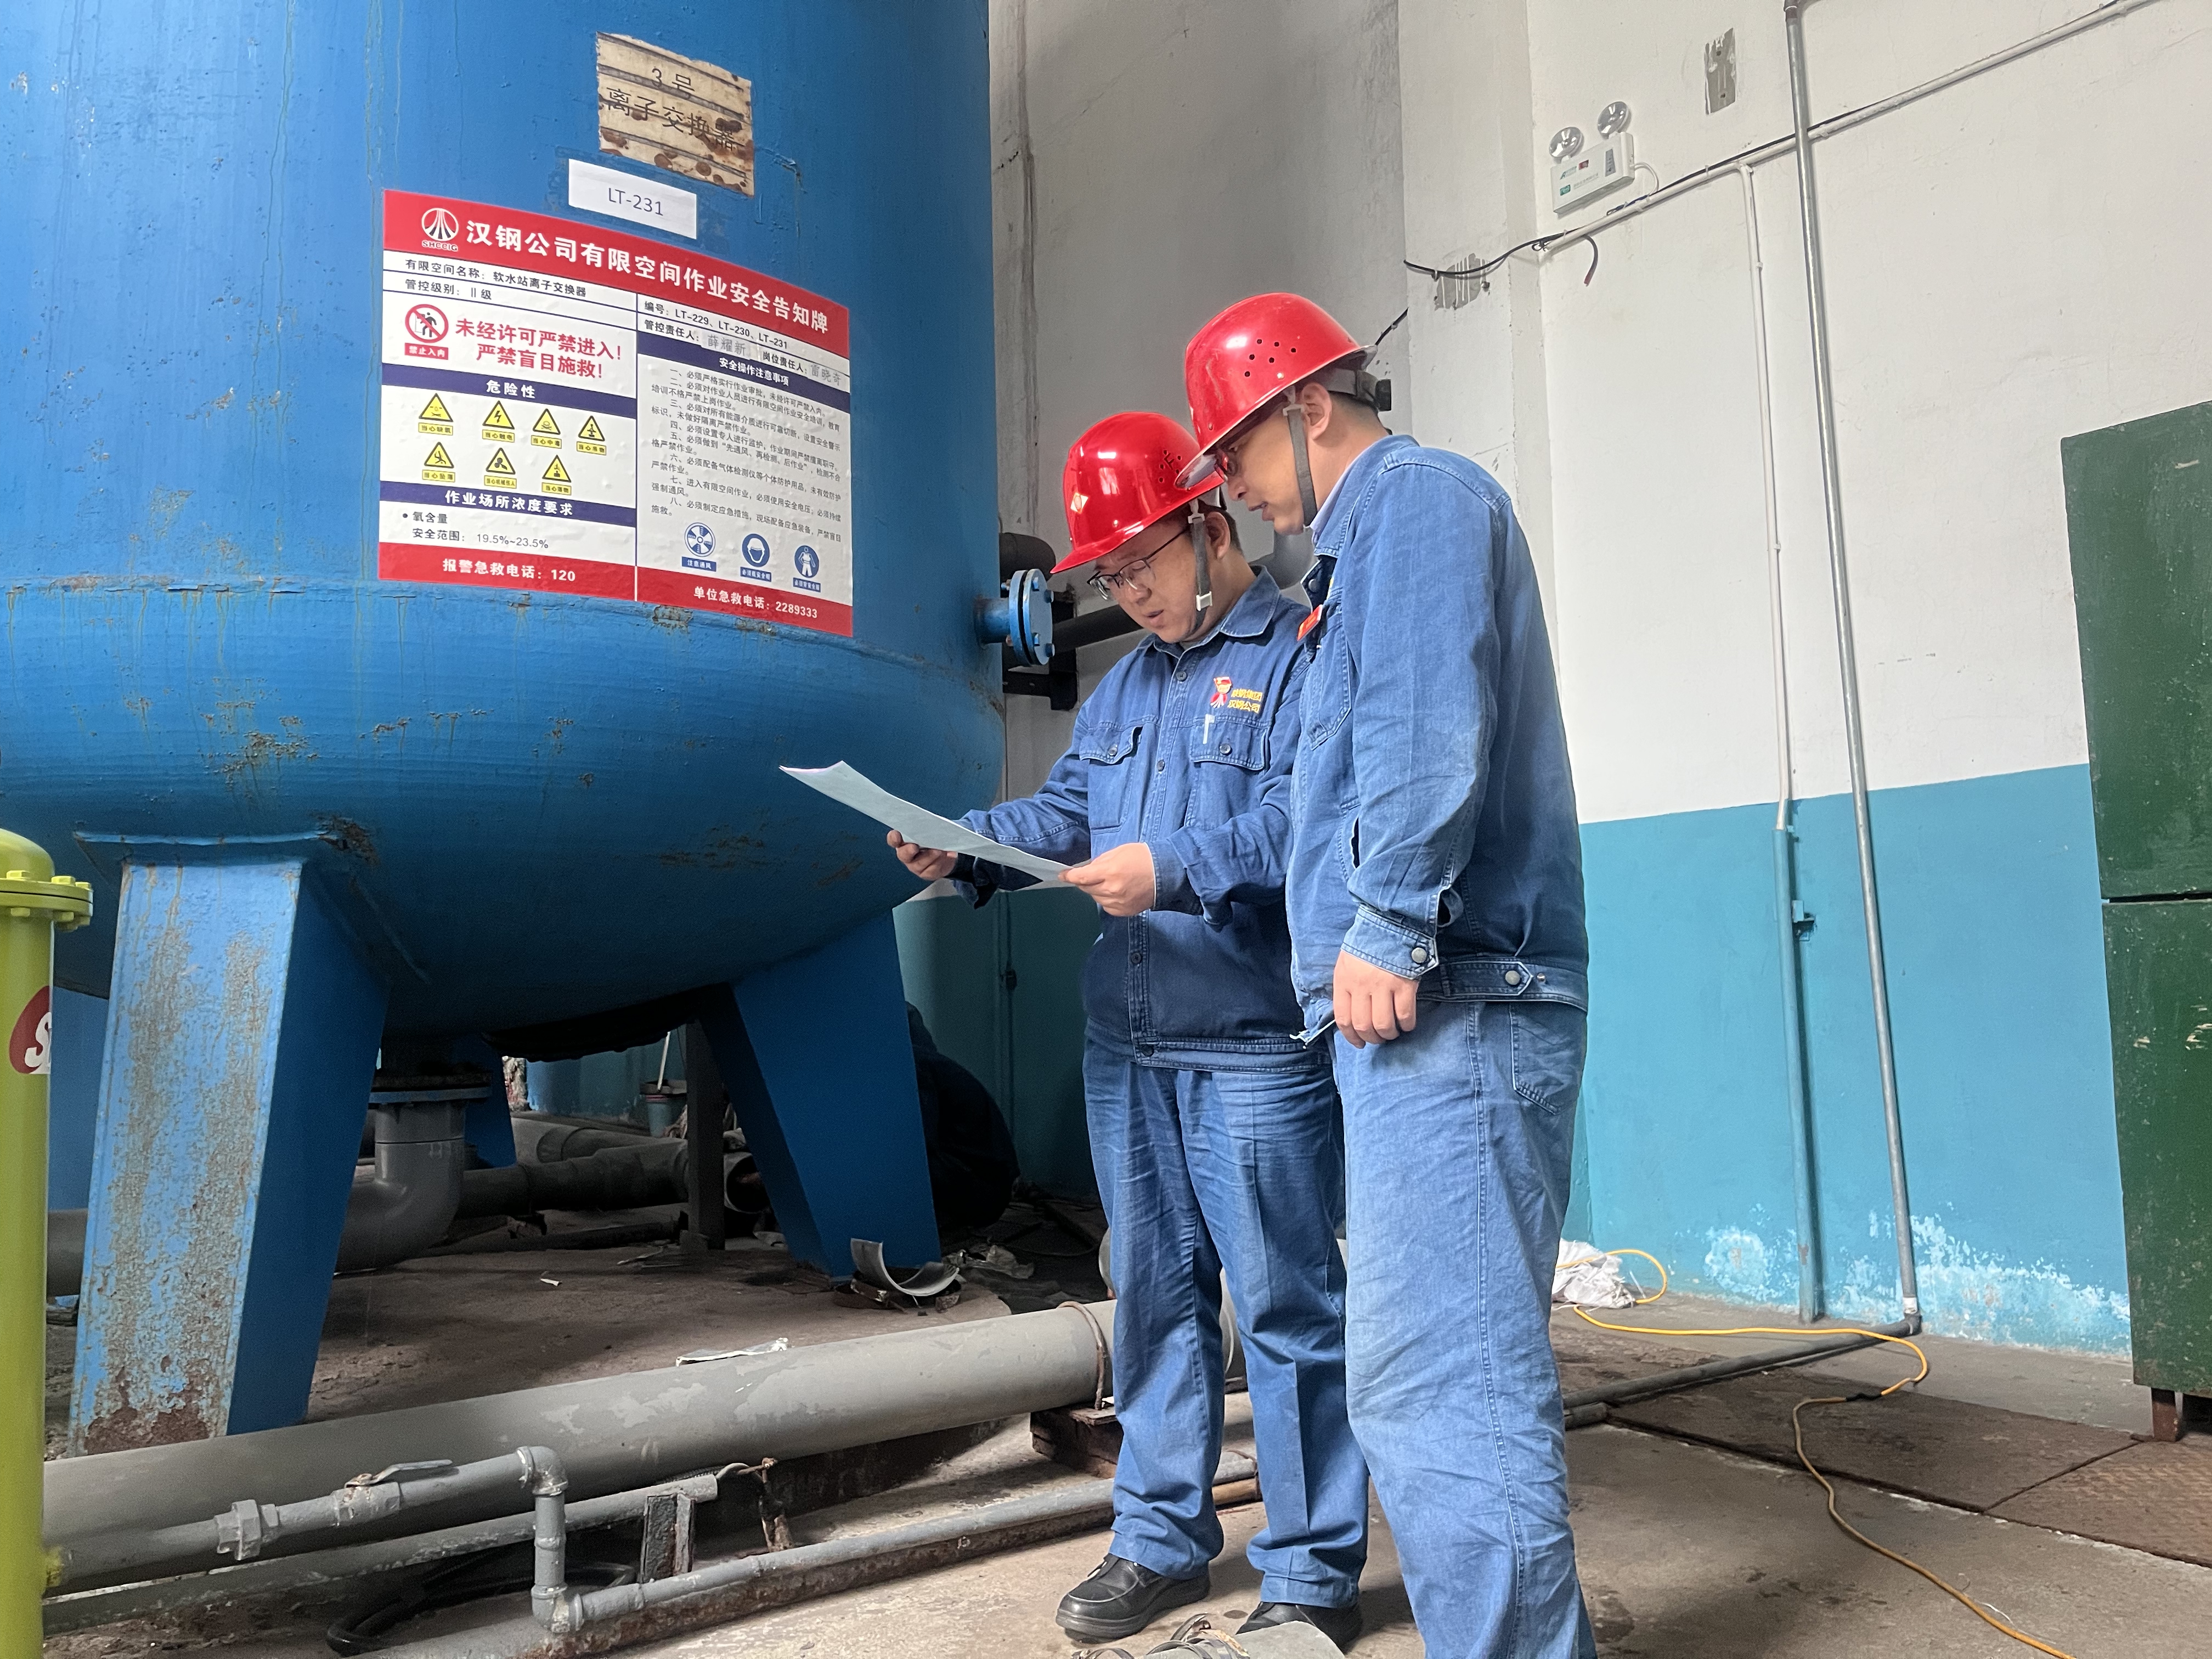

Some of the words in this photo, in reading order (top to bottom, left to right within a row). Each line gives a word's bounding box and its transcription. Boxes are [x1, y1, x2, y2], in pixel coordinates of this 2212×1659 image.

[606, 88, 744, 151] 离子交换器
[608, 188, 664, 216] LT-231
[422, 240, 458, 252] SHCCIG
[466, 221, 828, 334] 汉钢公司有限空间作业安全告知牌
[455, 318, 621, 360] 未经许可严禁进入！
[476, 343, 602, 379] 严禁盲目施救！
[719, 357, 789, 386] 安全操作注意事项
[486, 380, 536, 399] 危险性
[444, 490, 573, 516] 作业场所浓度要求
[412, 511, 448, 524] 氧含量
